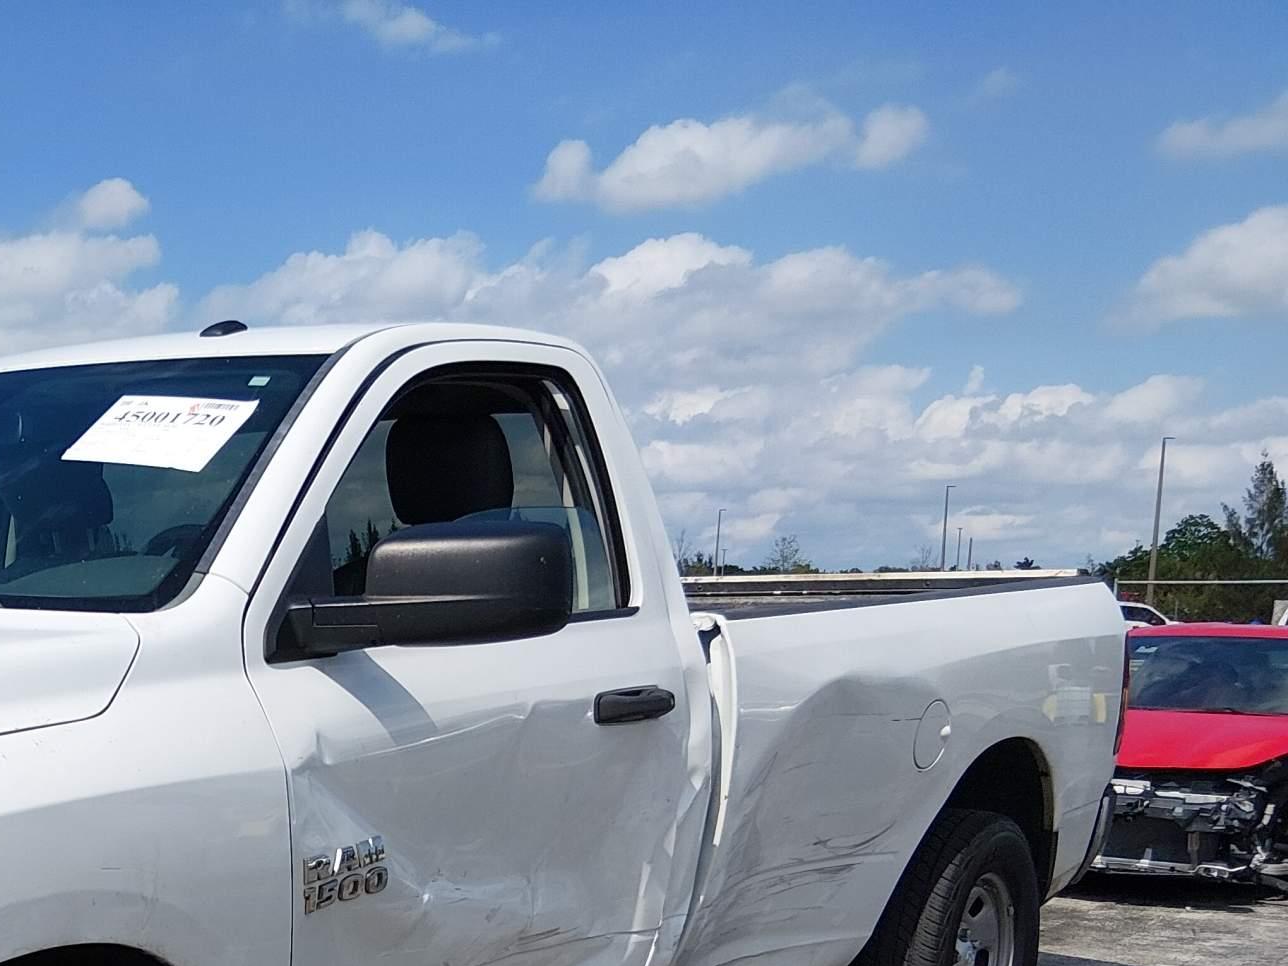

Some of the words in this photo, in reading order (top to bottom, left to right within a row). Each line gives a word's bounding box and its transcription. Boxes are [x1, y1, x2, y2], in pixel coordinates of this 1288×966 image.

[114, 410, 226, 427] 45001720
[302, 835, 386, 885] RAM
[304, 866, 388, 915] 1500
